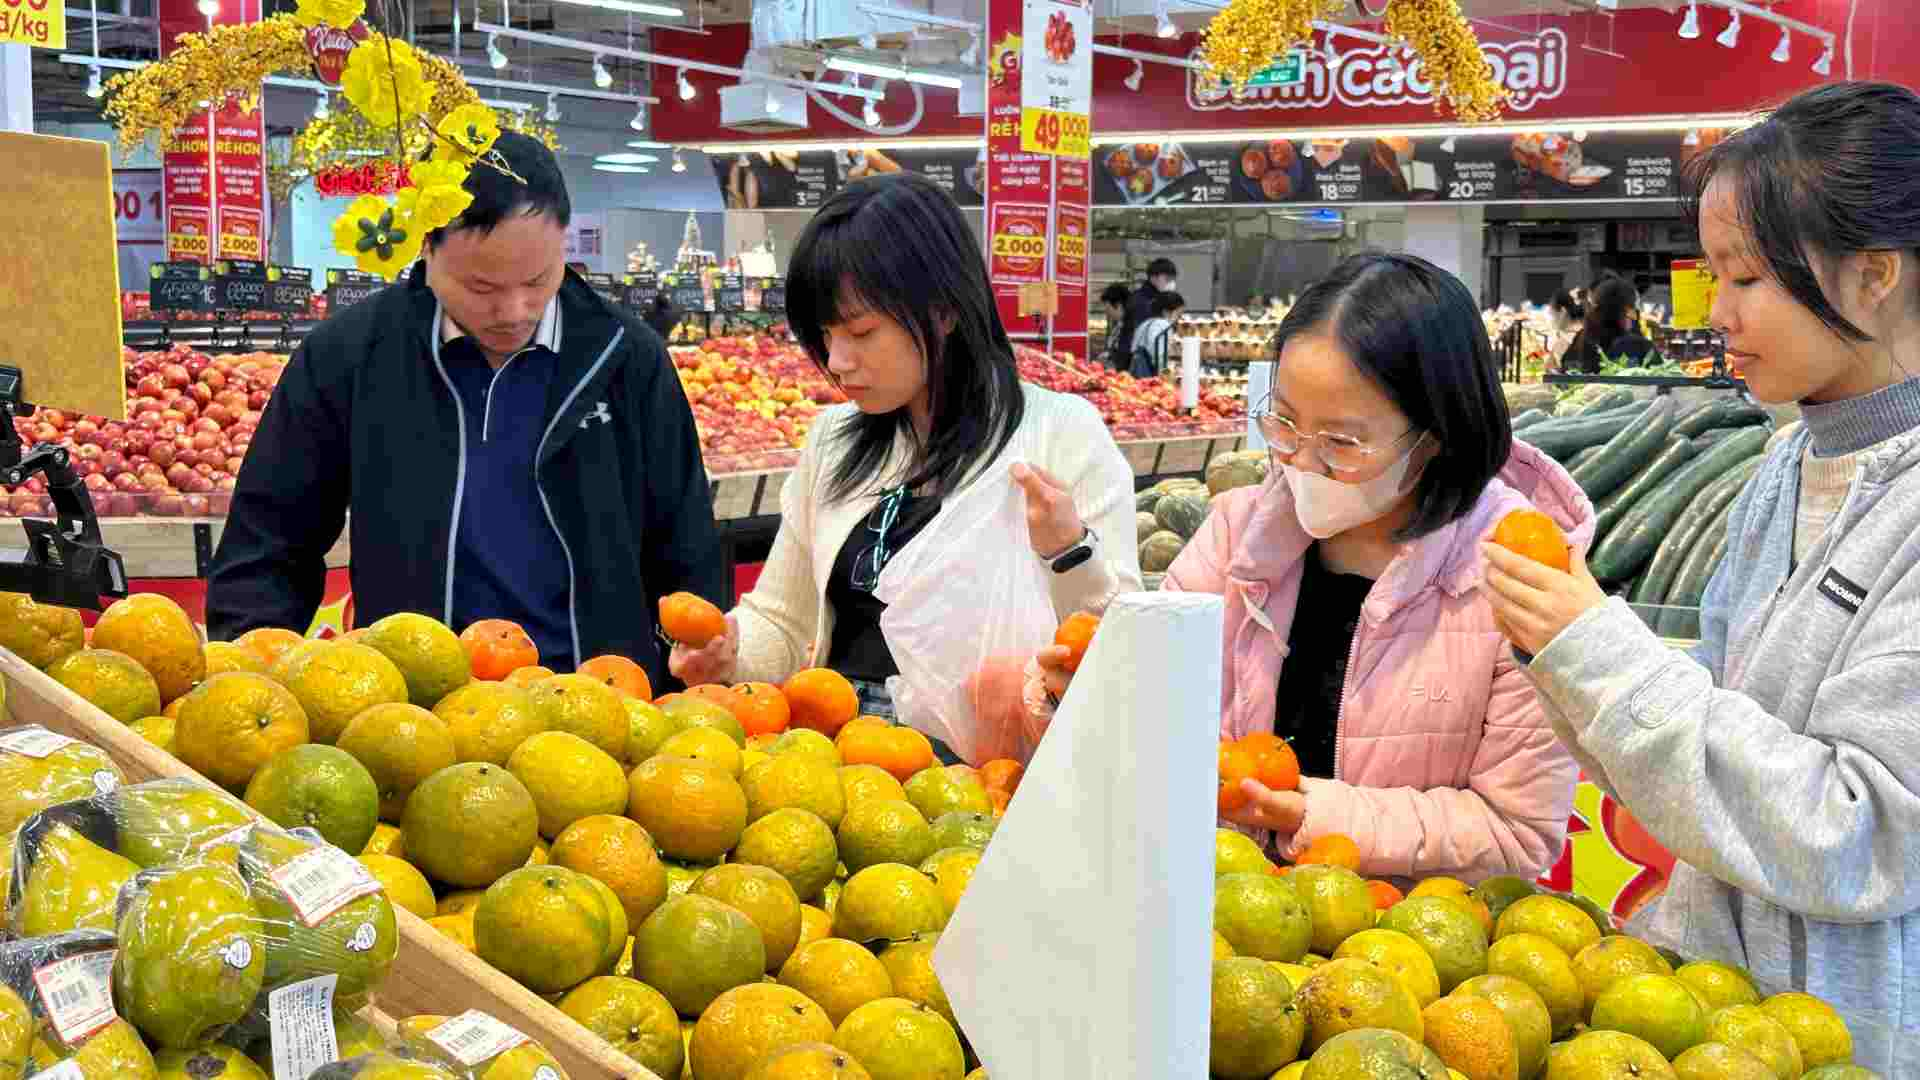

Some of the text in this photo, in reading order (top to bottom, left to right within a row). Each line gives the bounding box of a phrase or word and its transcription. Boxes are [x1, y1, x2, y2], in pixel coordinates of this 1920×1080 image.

[1035, 113, 1058, 150] 49
[1191, 186, 1208, 202] 21
[1320, 184, 1338, 201] 18
[1449, 181, 1474, 199] 20
[1624, 178, 1644, 196] 15
